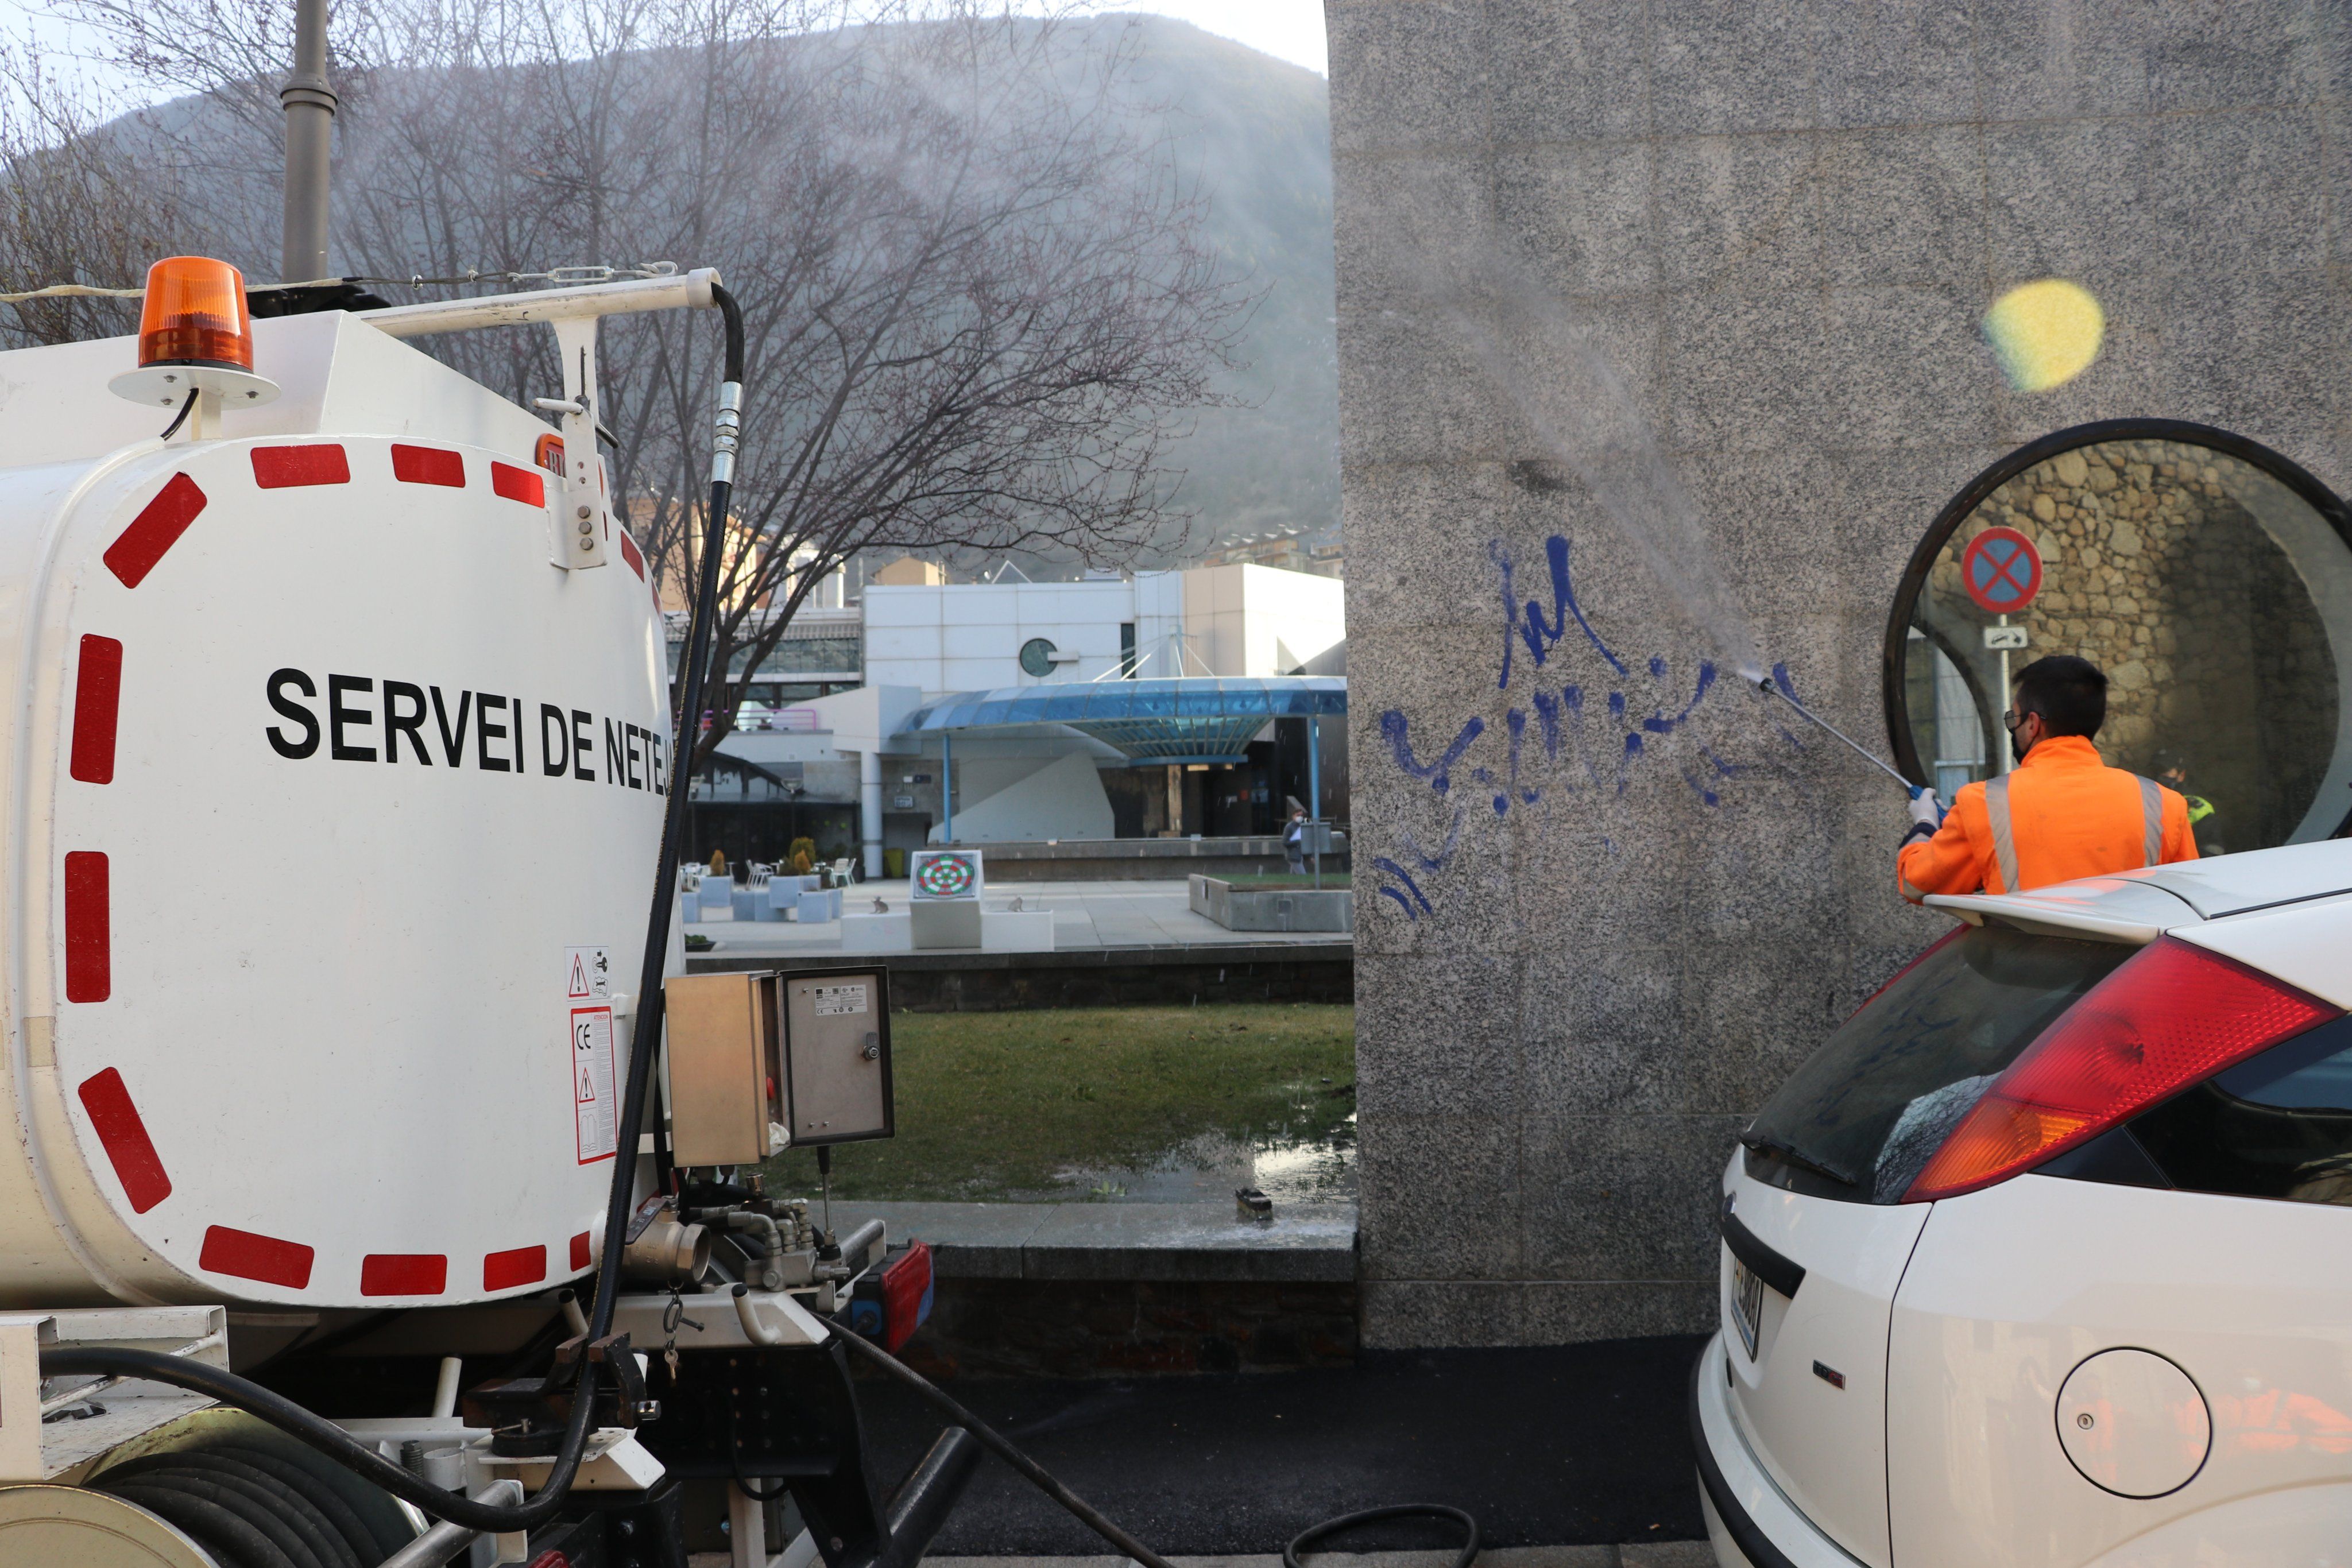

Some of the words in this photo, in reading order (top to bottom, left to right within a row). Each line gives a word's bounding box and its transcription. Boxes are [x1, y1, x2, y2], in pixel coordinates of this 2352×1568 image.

[266, 668, 524, 773] SERVEI
[541, 702, 595, 781] DE
[576, 1023, 591, 1050] CE
